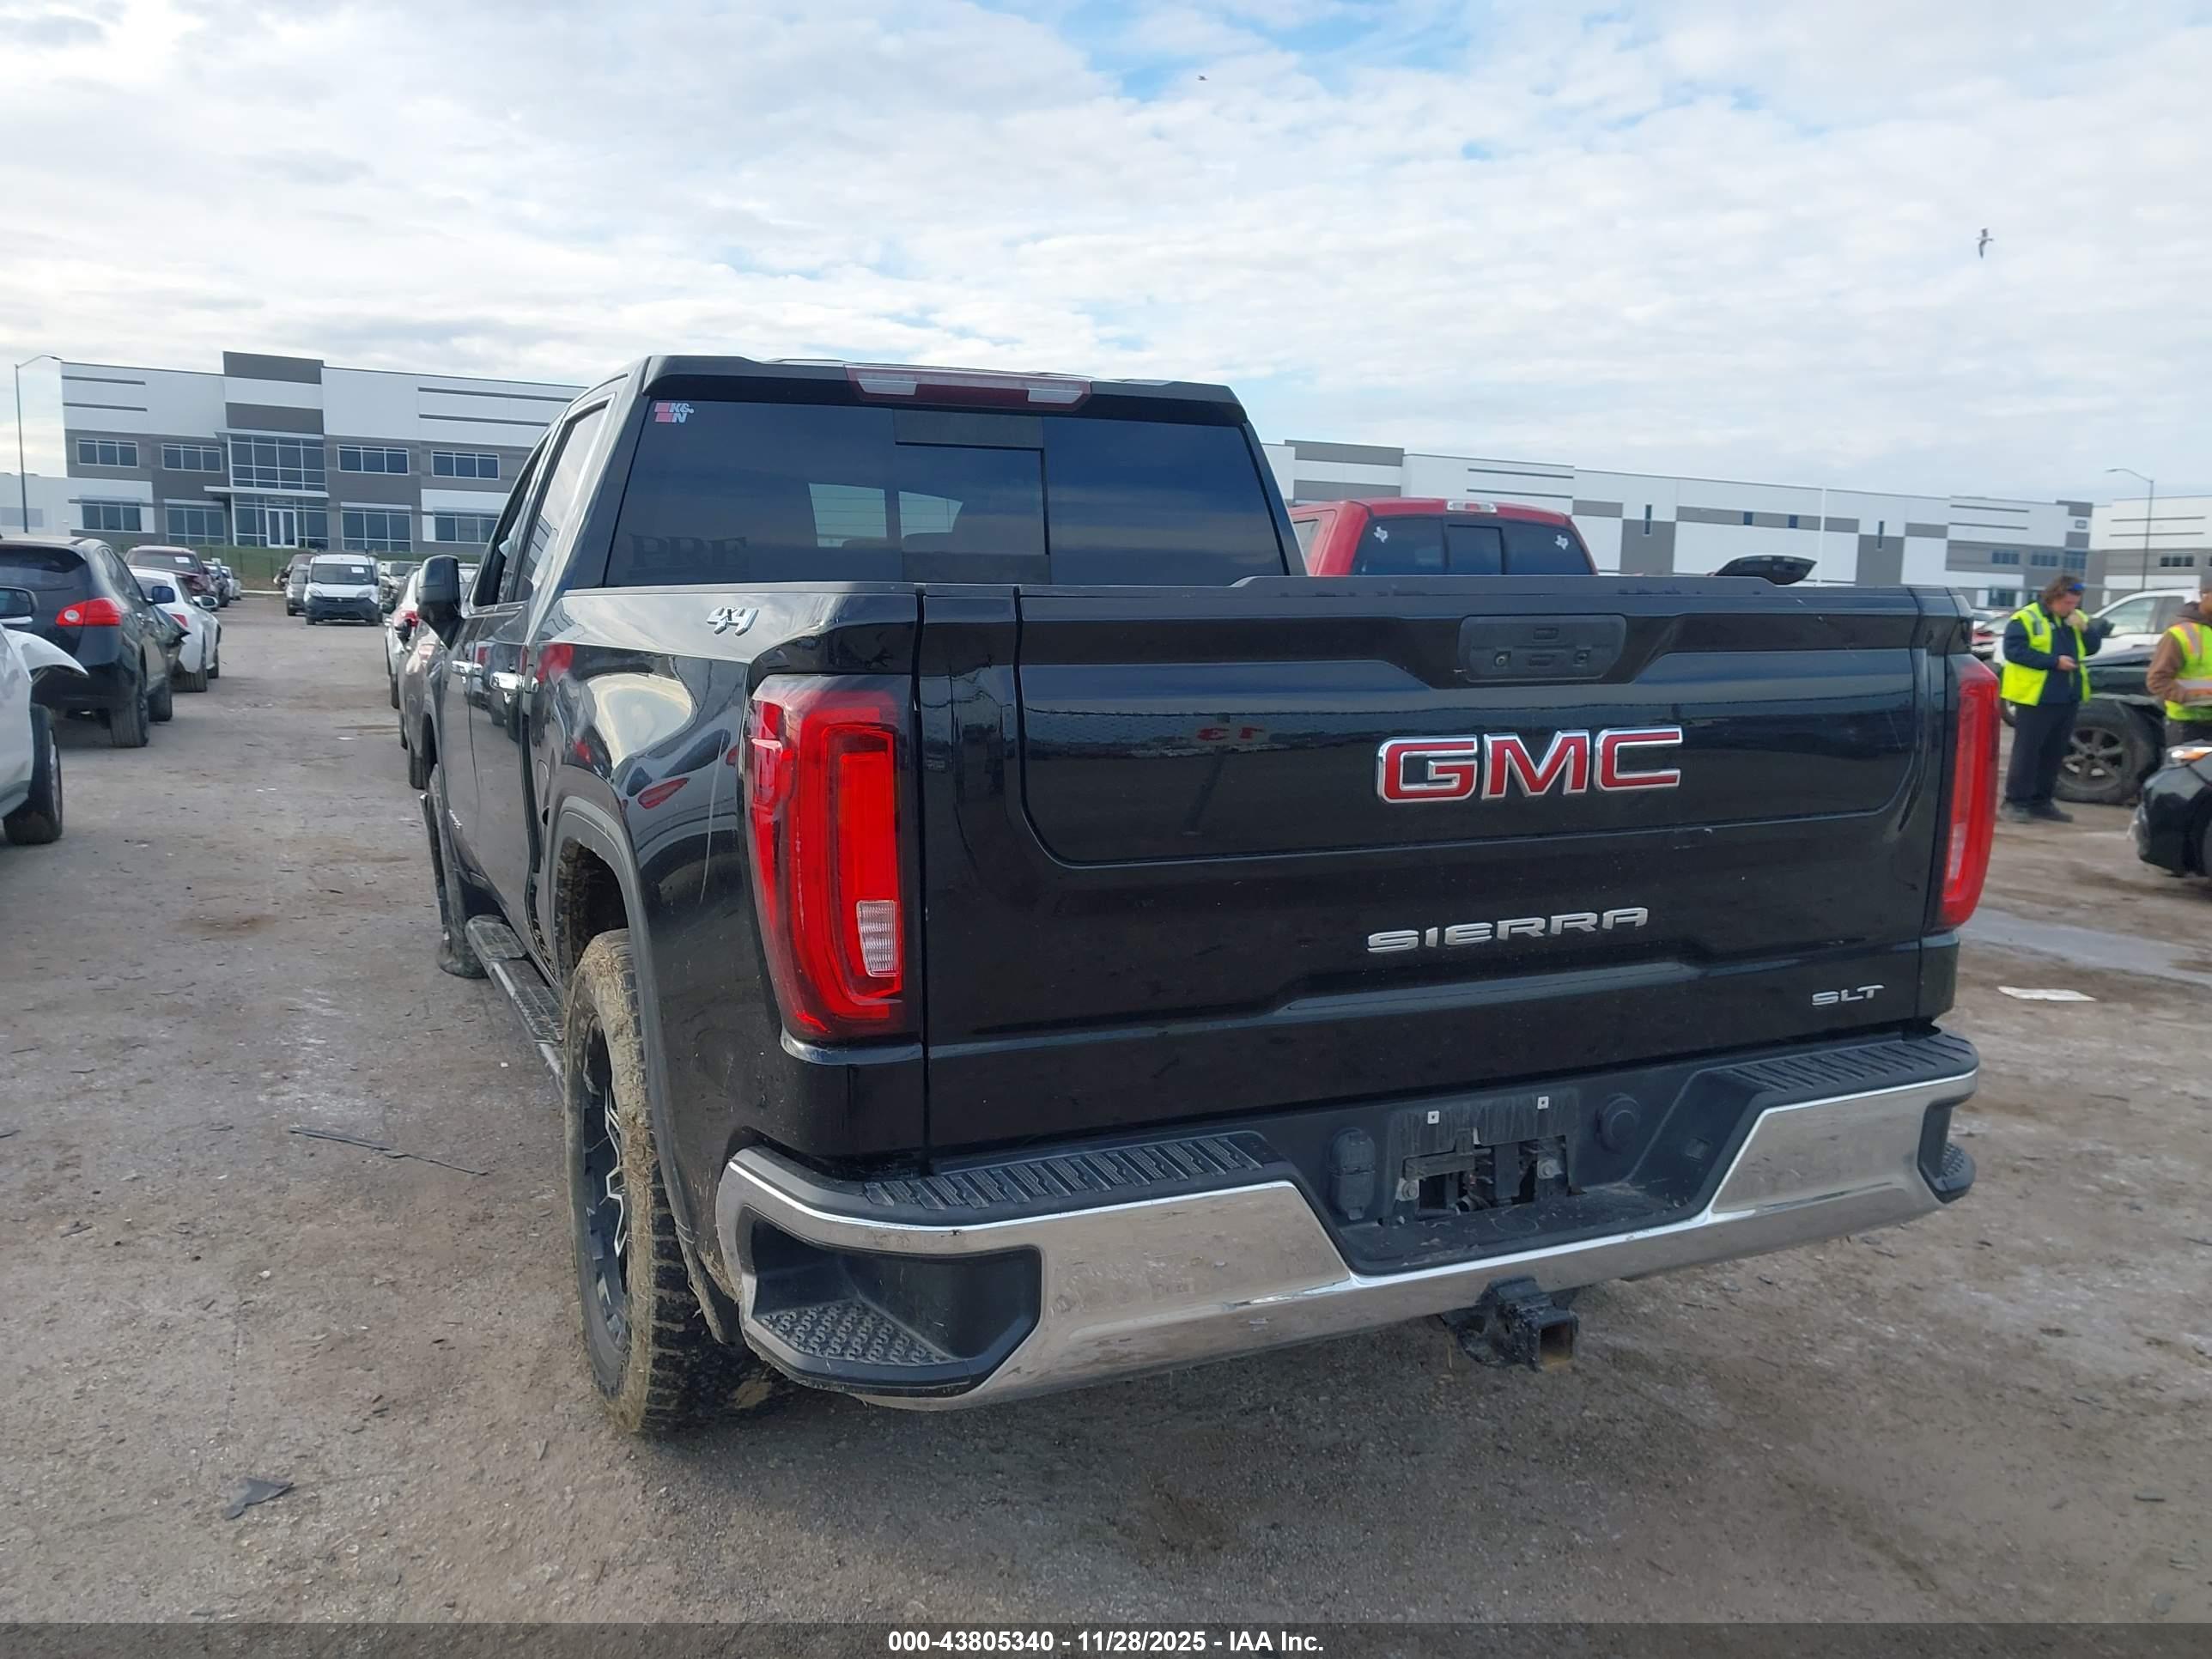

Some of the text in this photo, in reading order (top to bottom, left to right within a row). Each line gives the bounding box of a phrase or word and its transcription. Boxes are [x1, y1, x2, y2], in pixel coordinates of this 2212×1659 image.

[1377, 725, 1683, 804] GMC
[1367, 907, 1649, 953] SIERRA
[1812, 984, 1885, 1006] SLT
